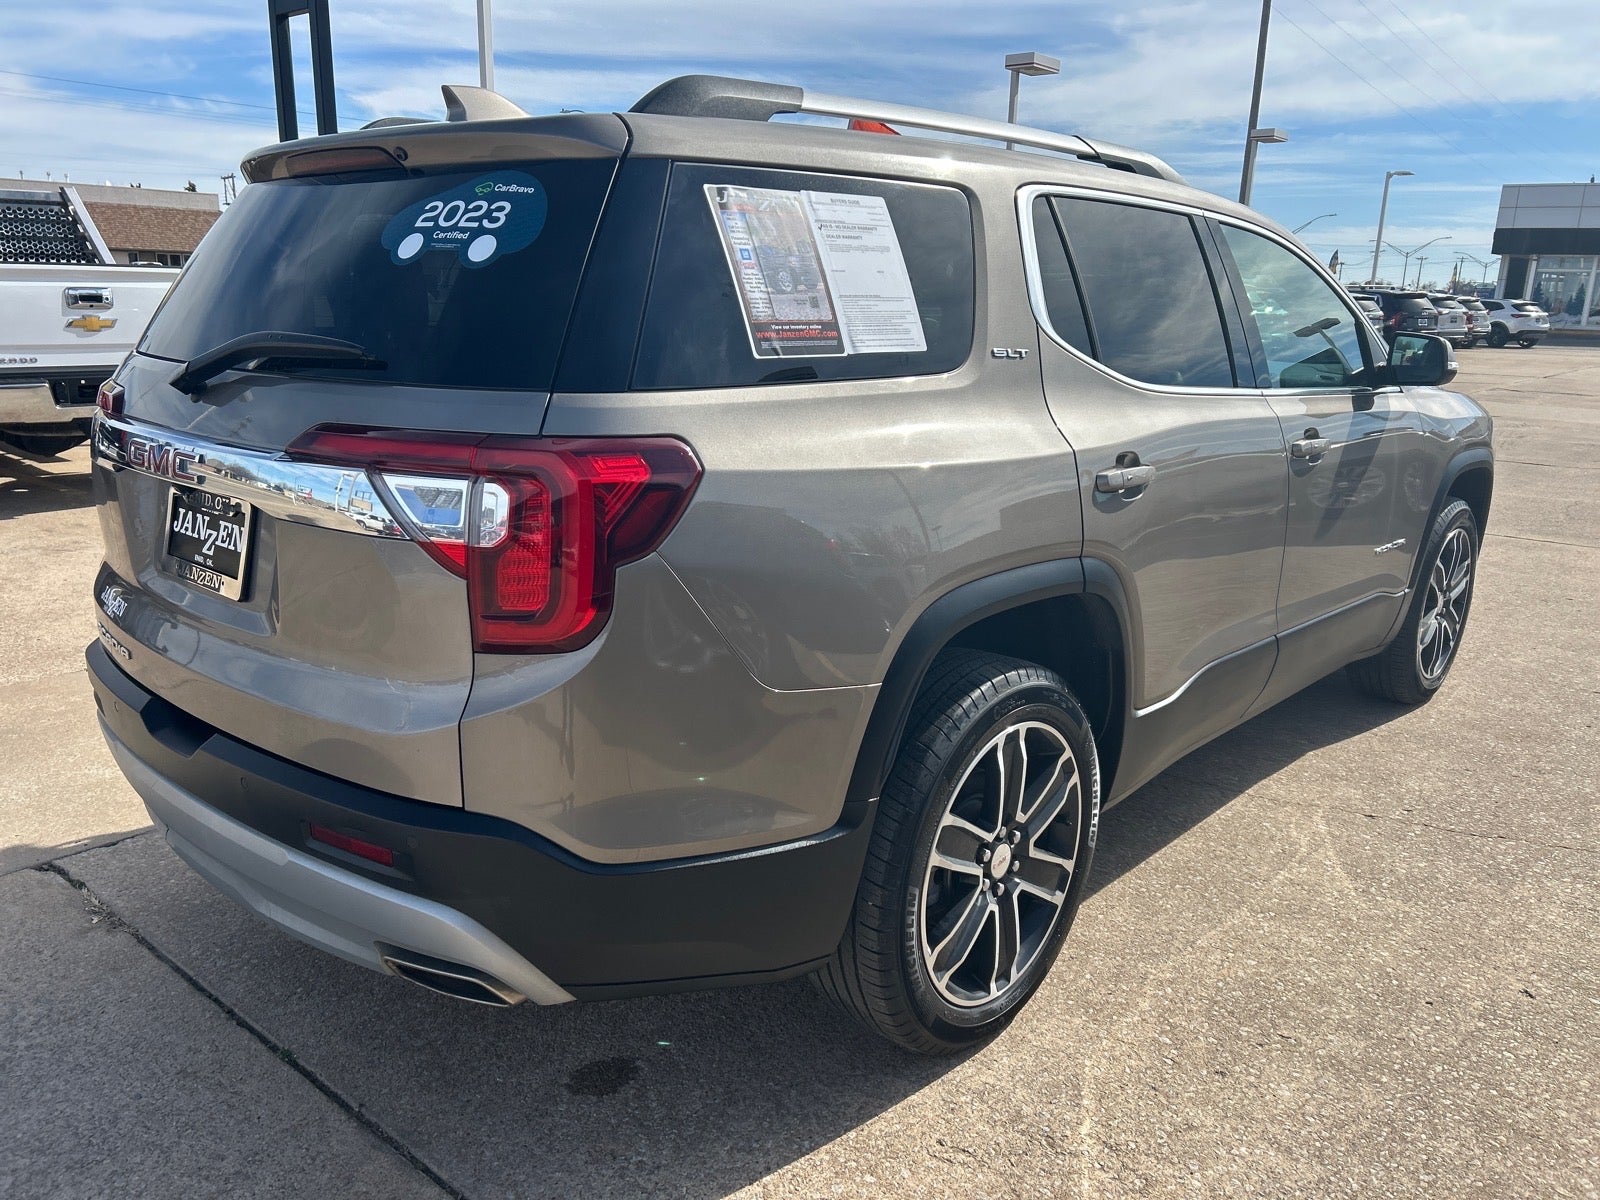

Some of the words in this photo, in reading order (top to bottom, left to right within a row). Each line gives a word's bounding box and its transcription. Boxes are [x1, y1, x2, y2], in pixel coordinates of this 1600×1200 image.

[494, 183, 535, 194] CarBravo
[414, 200, 512, 229] 2023
[433, 230, 470, 239] Certified
[756, 330, 838, 338] www.JanzenGMC.com
[992, 347, 1029, 359] SLT
[128, 438, 206, 484] GMC
[173, 508, 244, 556] JANZEN
[178, 563, 222, 589] JANZEN
[906, 888, 924, 991] MICHELIN
